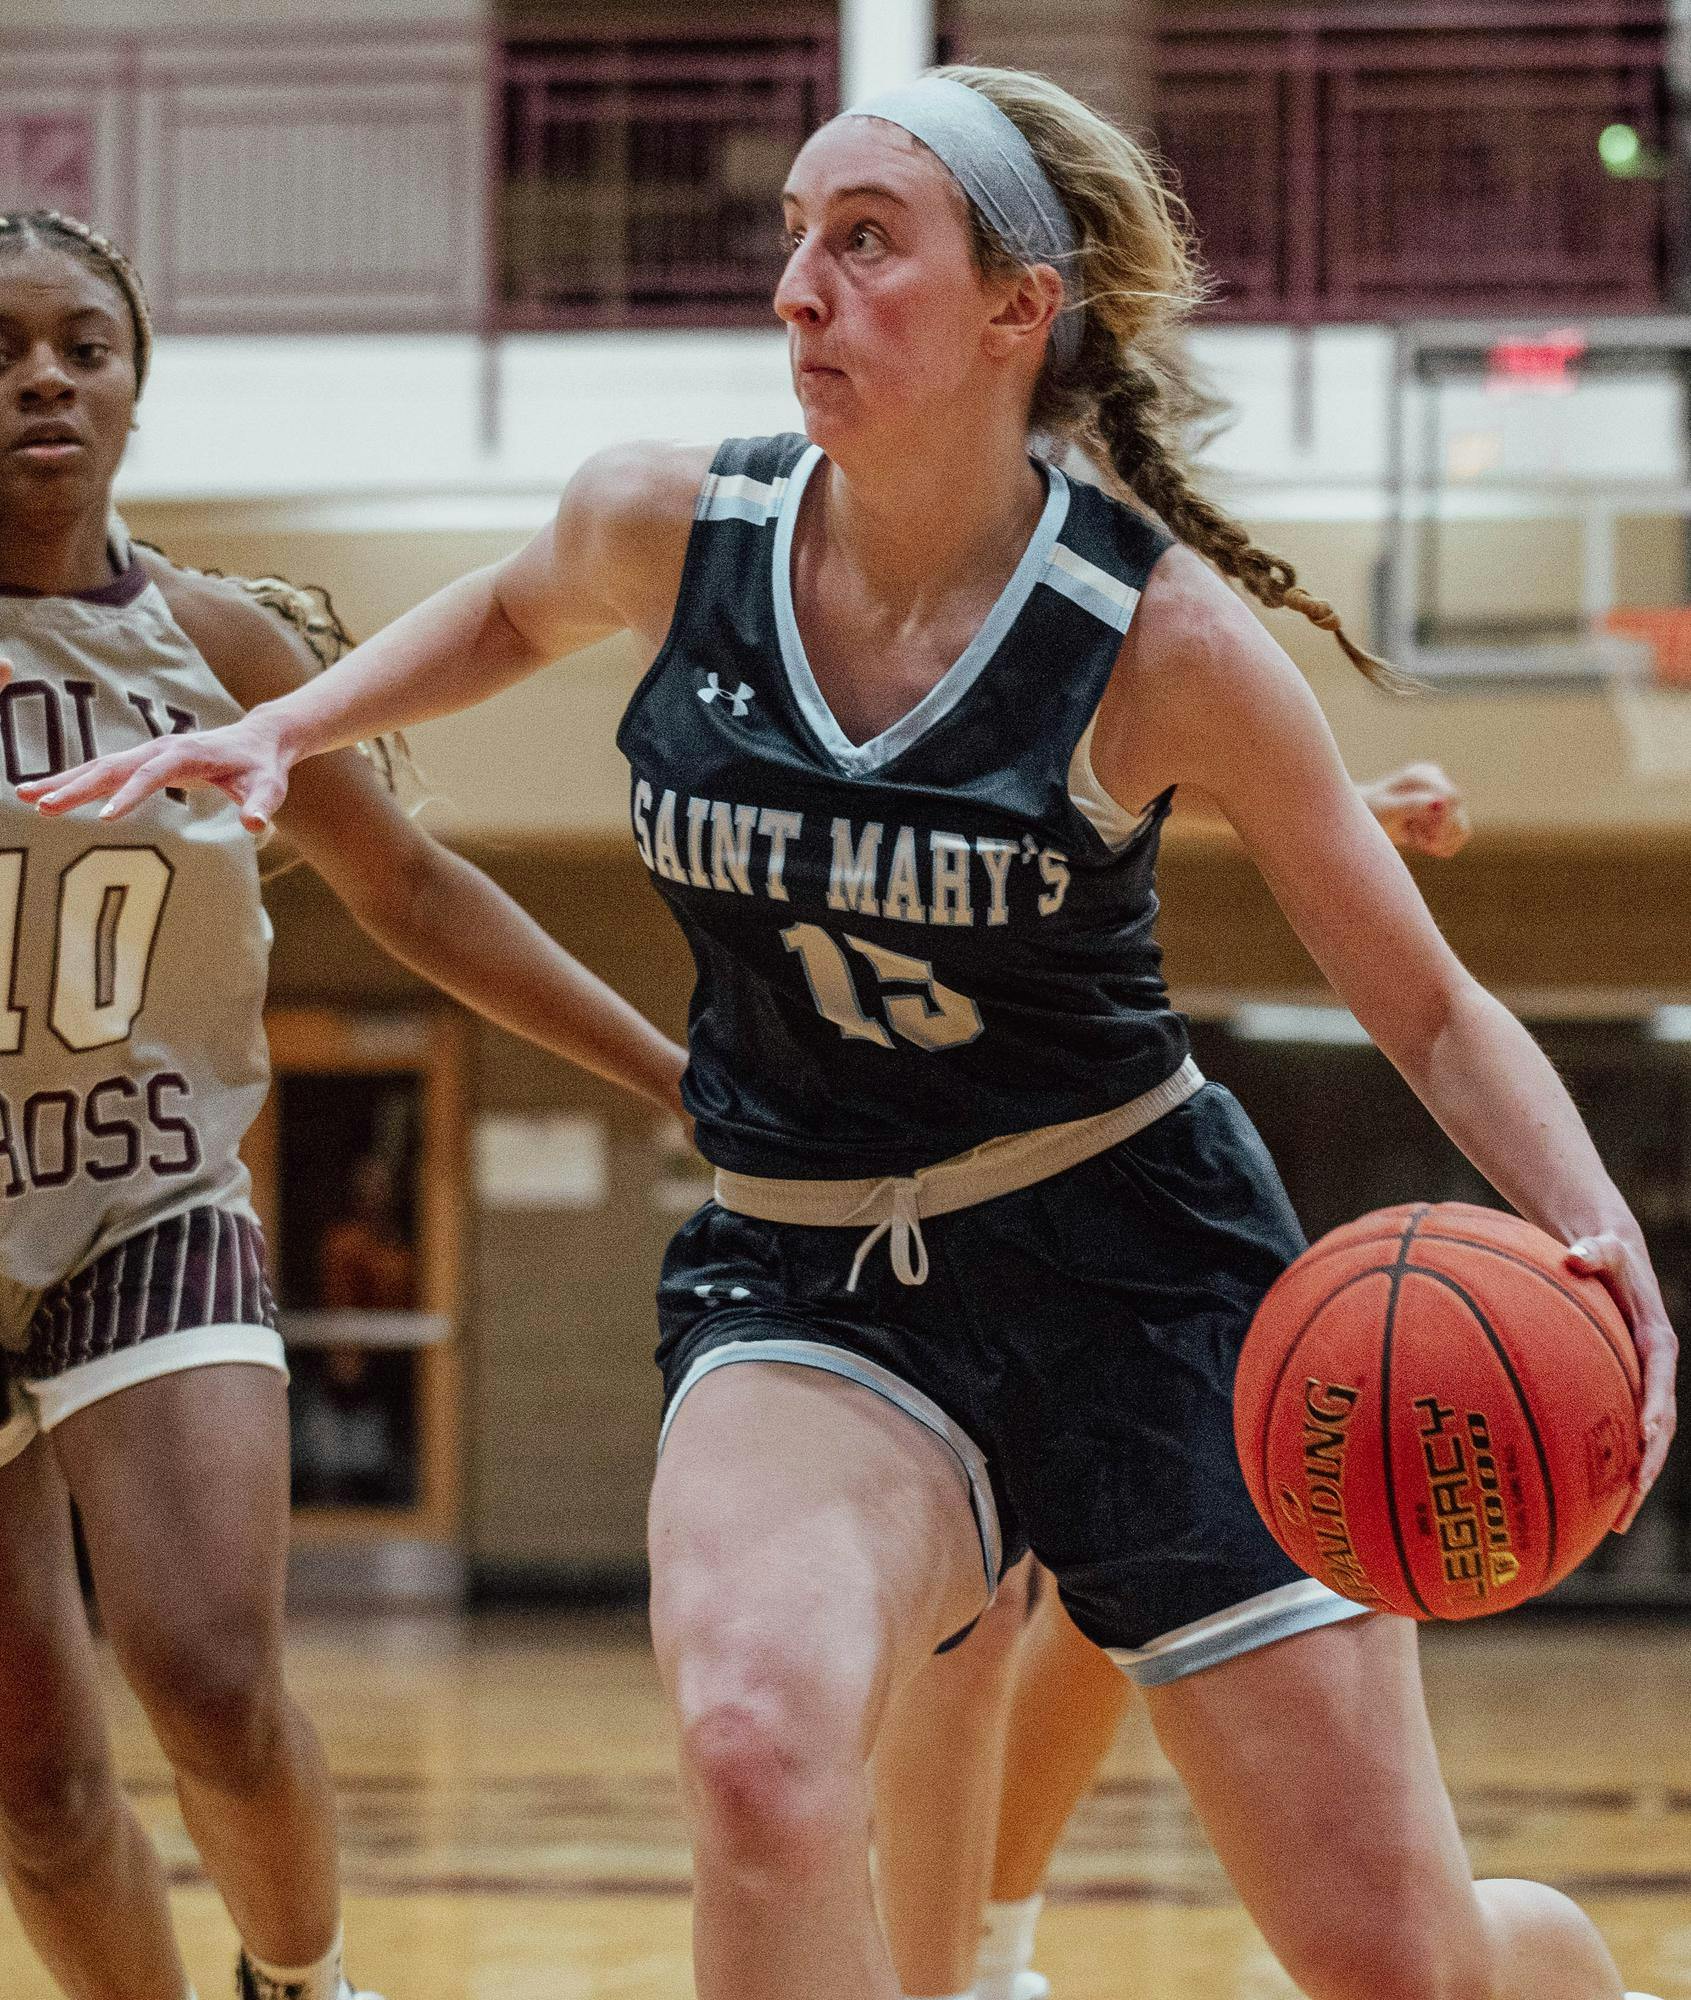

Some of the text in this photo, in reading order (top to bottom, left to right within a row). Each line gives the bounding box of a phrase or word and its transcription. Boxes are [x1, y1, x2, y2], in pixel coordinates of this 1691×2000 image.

[634, 779, 1071, 927] SAINT MARY'S
[779, 921, 985, 1053] 15
[1303, 1376, 1396, 1608] PALDING
[1413, 1395, 1489, 1598] LEGACY
